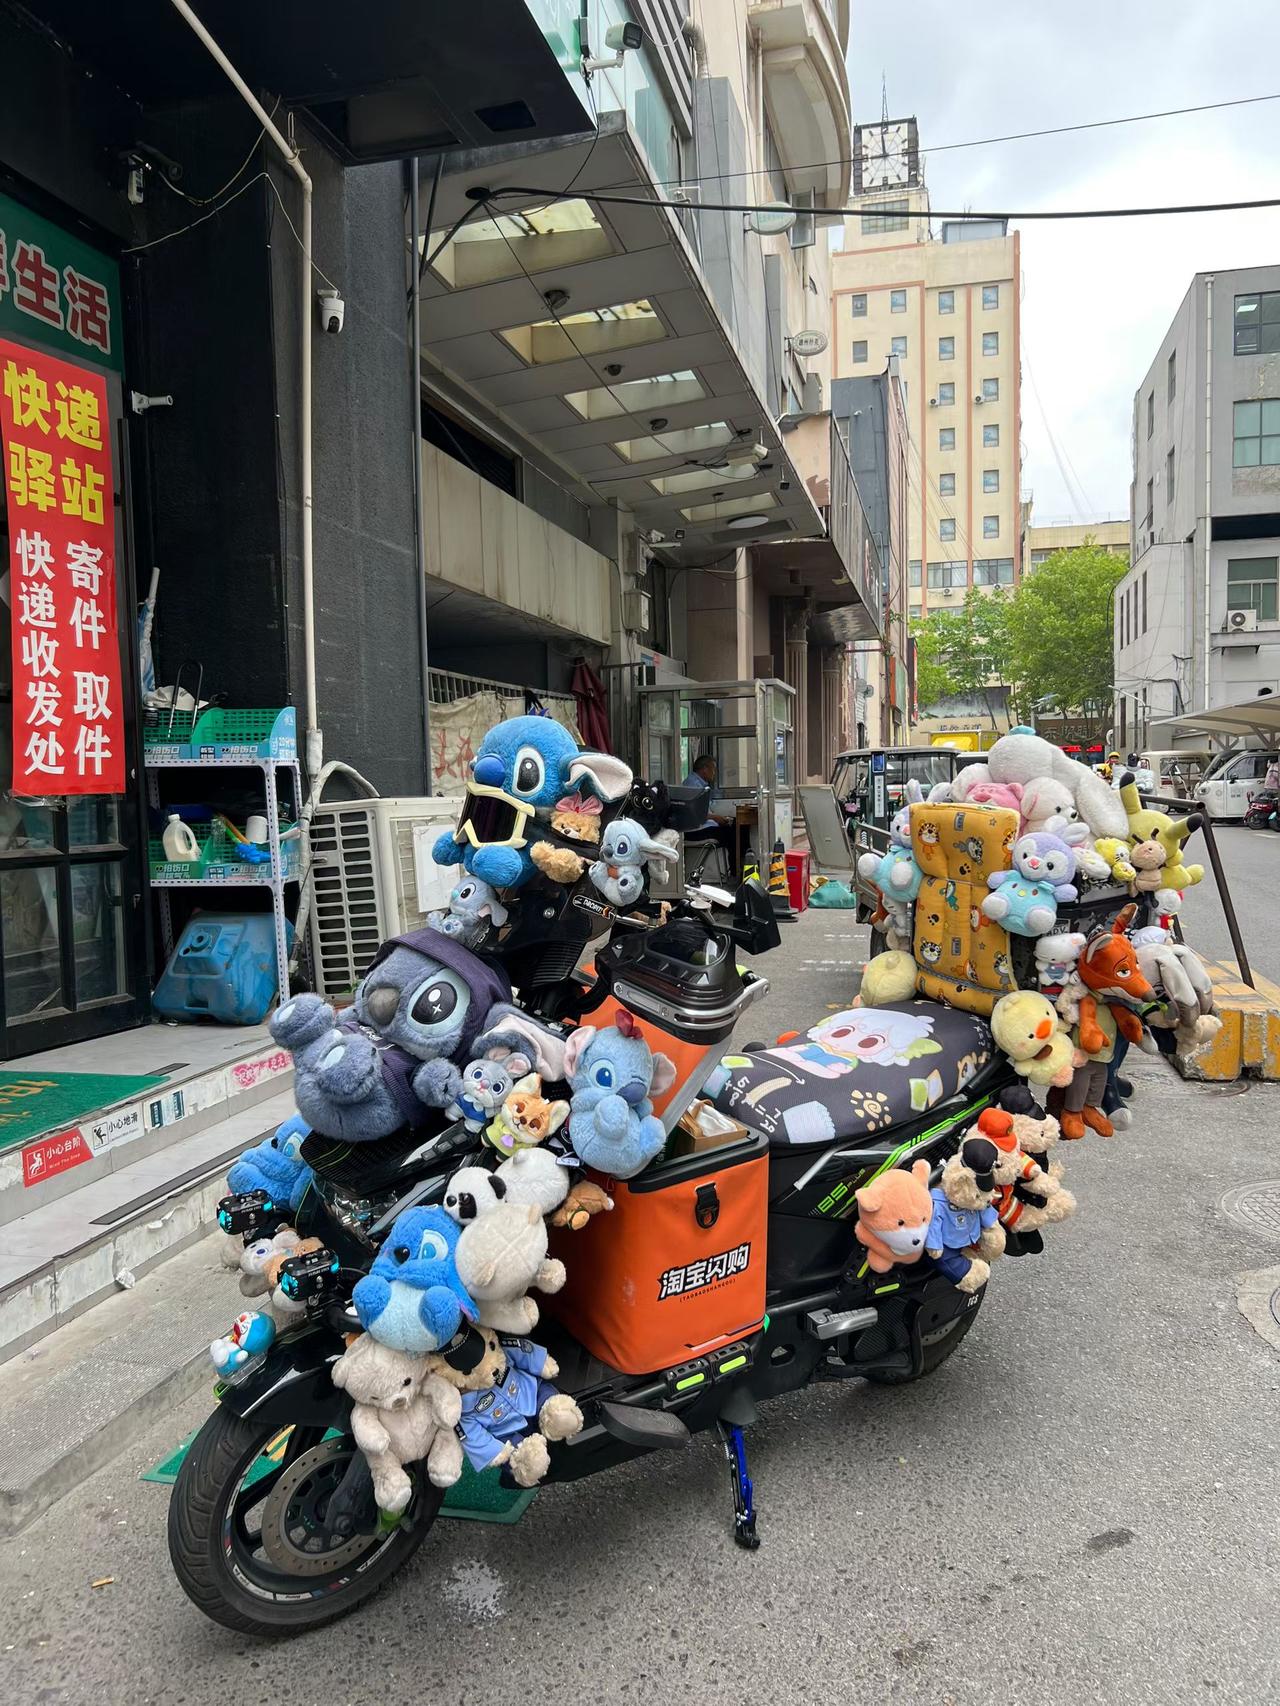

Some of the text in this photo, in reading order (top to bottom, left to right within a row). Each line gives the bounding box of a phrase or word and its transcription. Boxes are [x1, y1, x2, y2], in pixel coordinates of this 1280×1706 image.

[0, 228, 111, 355] 生活
[3, 360, 103, 451] 快递
[8, 441, 105, 525] 驿站
[16, 528, 65, 776] 快递收发处
[66, 540, 113, 776] 寄件 取件
[46, 1135, 81, 1159] 小心台阶
[108, 1111, 138, 1133] 小心地滑
[658, 1243, 751, 1300] 淘宝闪购
